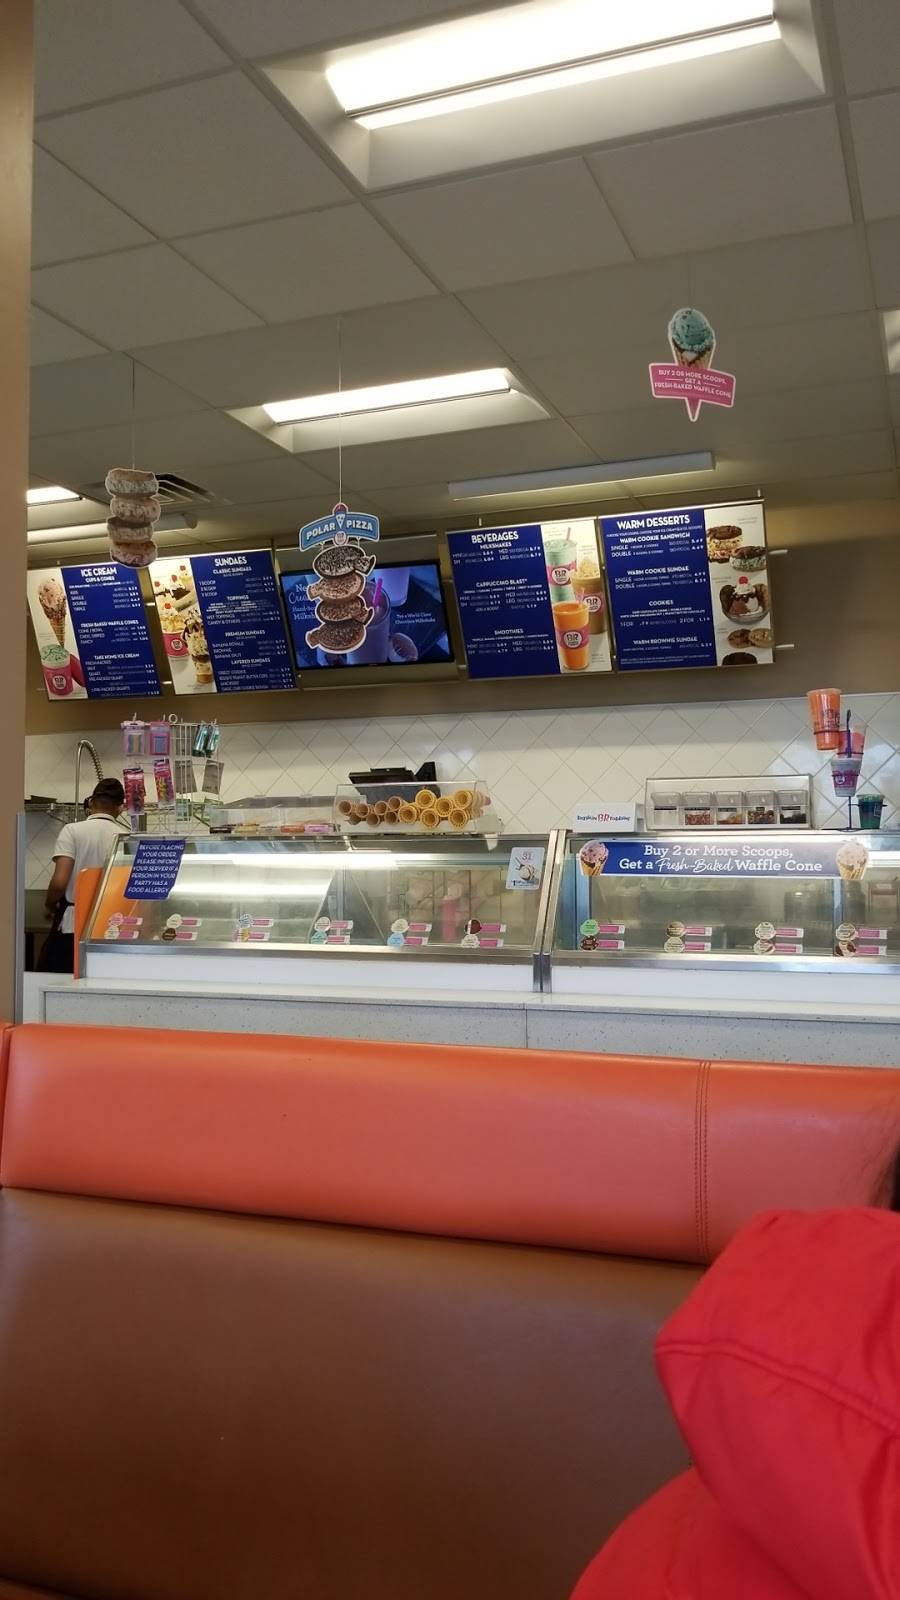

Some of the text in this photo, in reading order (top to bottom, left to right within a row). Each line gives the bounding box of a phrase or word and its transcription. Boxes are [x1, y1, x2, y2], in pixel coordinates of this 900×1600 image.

[655, 382, 731, 398] FRESH-BAKED WAFFLE CONE
[617, 515, 690, 530] WARM DESSERTS
[306, 522, 336, 540] POLAR
[346, 520, 373, 531] PIZZA
[471, 531, 519, 544] BEVERAGES
[638, 534, 659, 542] COOKIE
[660, 532, 690, 540] SANDWICH
[214, 556, 247, 567] SUNDAES
[80, 567, 117, 577] ICE CREAM
[296, 584, 308, 592] Ne
[644, 845, 793, 859] Buy 2 or More Scoops,
[619, 857, 823, 873] Get a Fresh-Baked Waffle Cone
